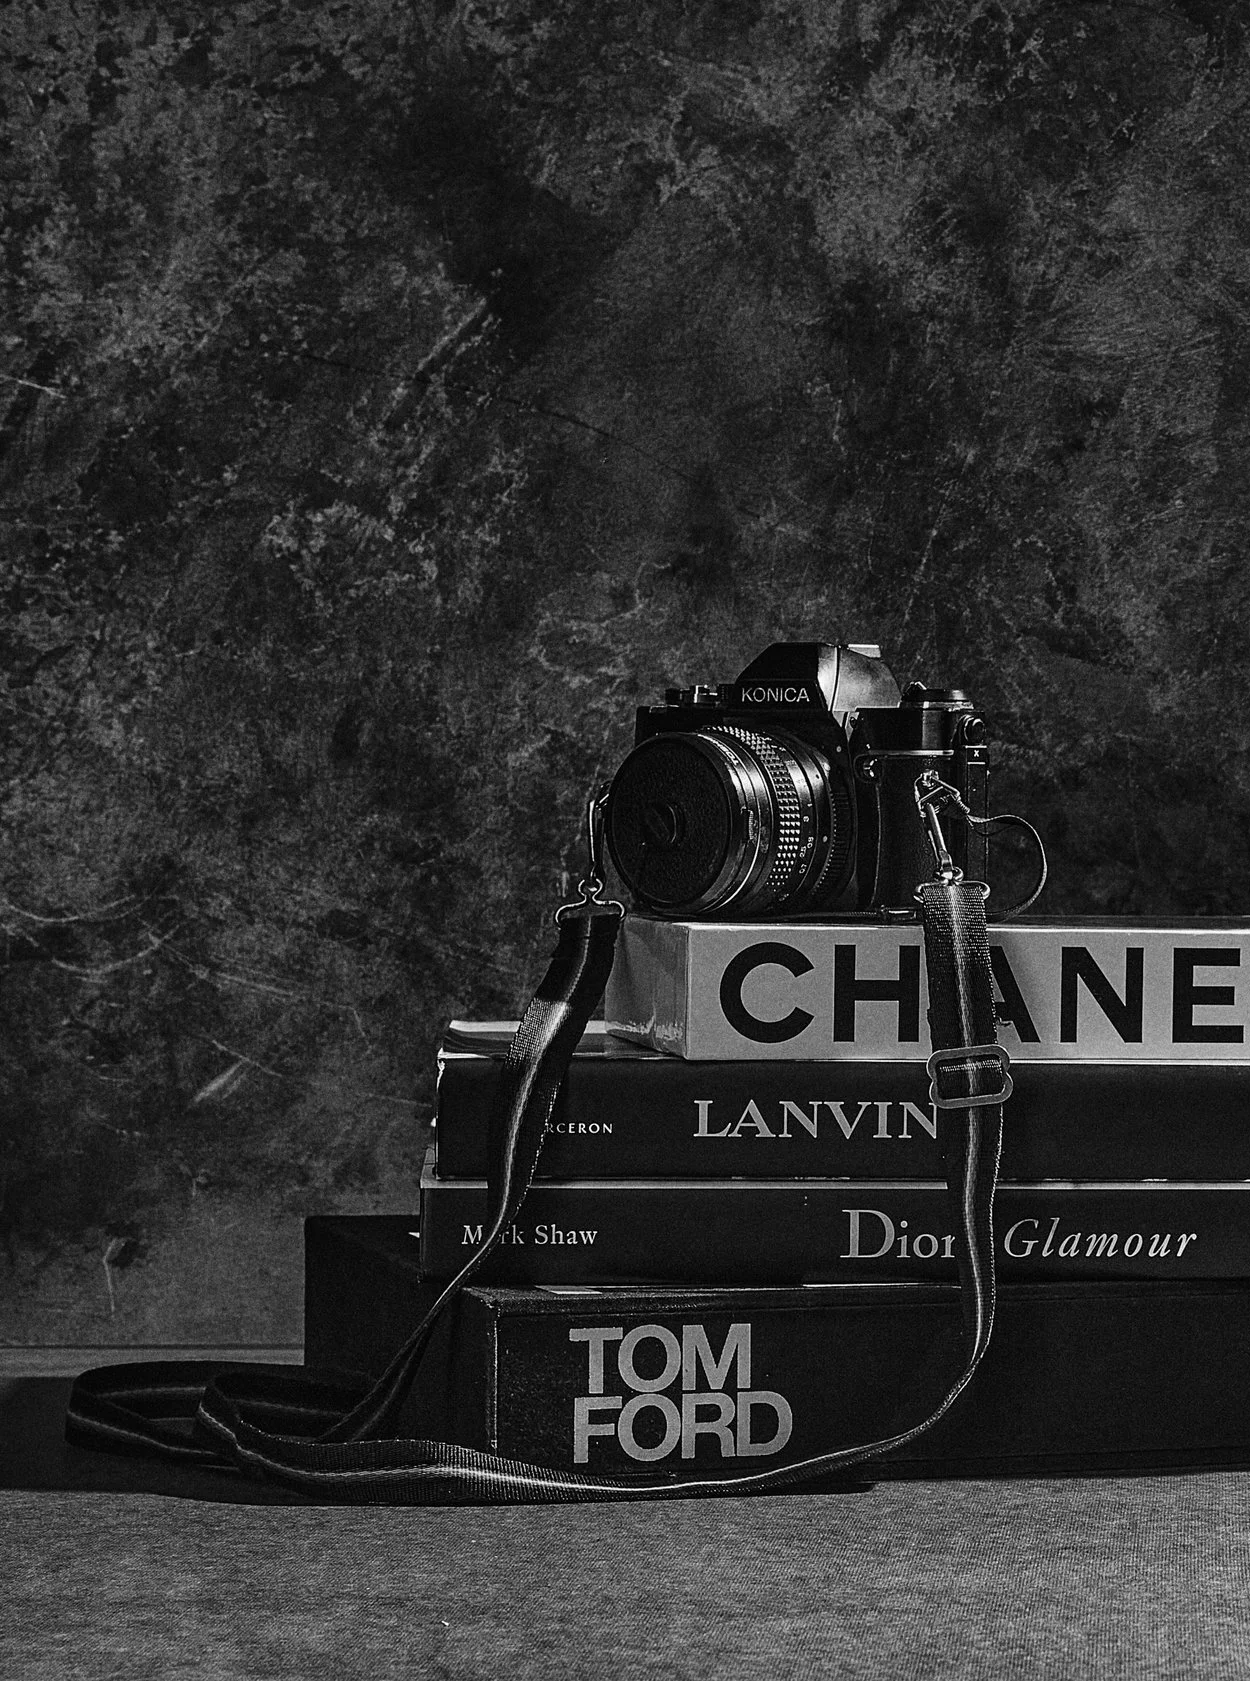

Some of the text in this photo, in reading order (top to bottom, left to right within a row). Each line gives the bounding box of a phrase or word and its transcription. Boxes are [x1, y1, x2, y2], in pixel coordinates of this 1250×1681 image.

[741, 687, 810, 703] KONICA
[693, 1099, 938, 1140] LANVIN
[461, 1223, 598, 1245] Mrk Shaw
[839, 1209, 1198, 1259] Dior Glamour
[568, 1322, 751, 1394] TOM
[573, 1391, 793, 1464] FORD
